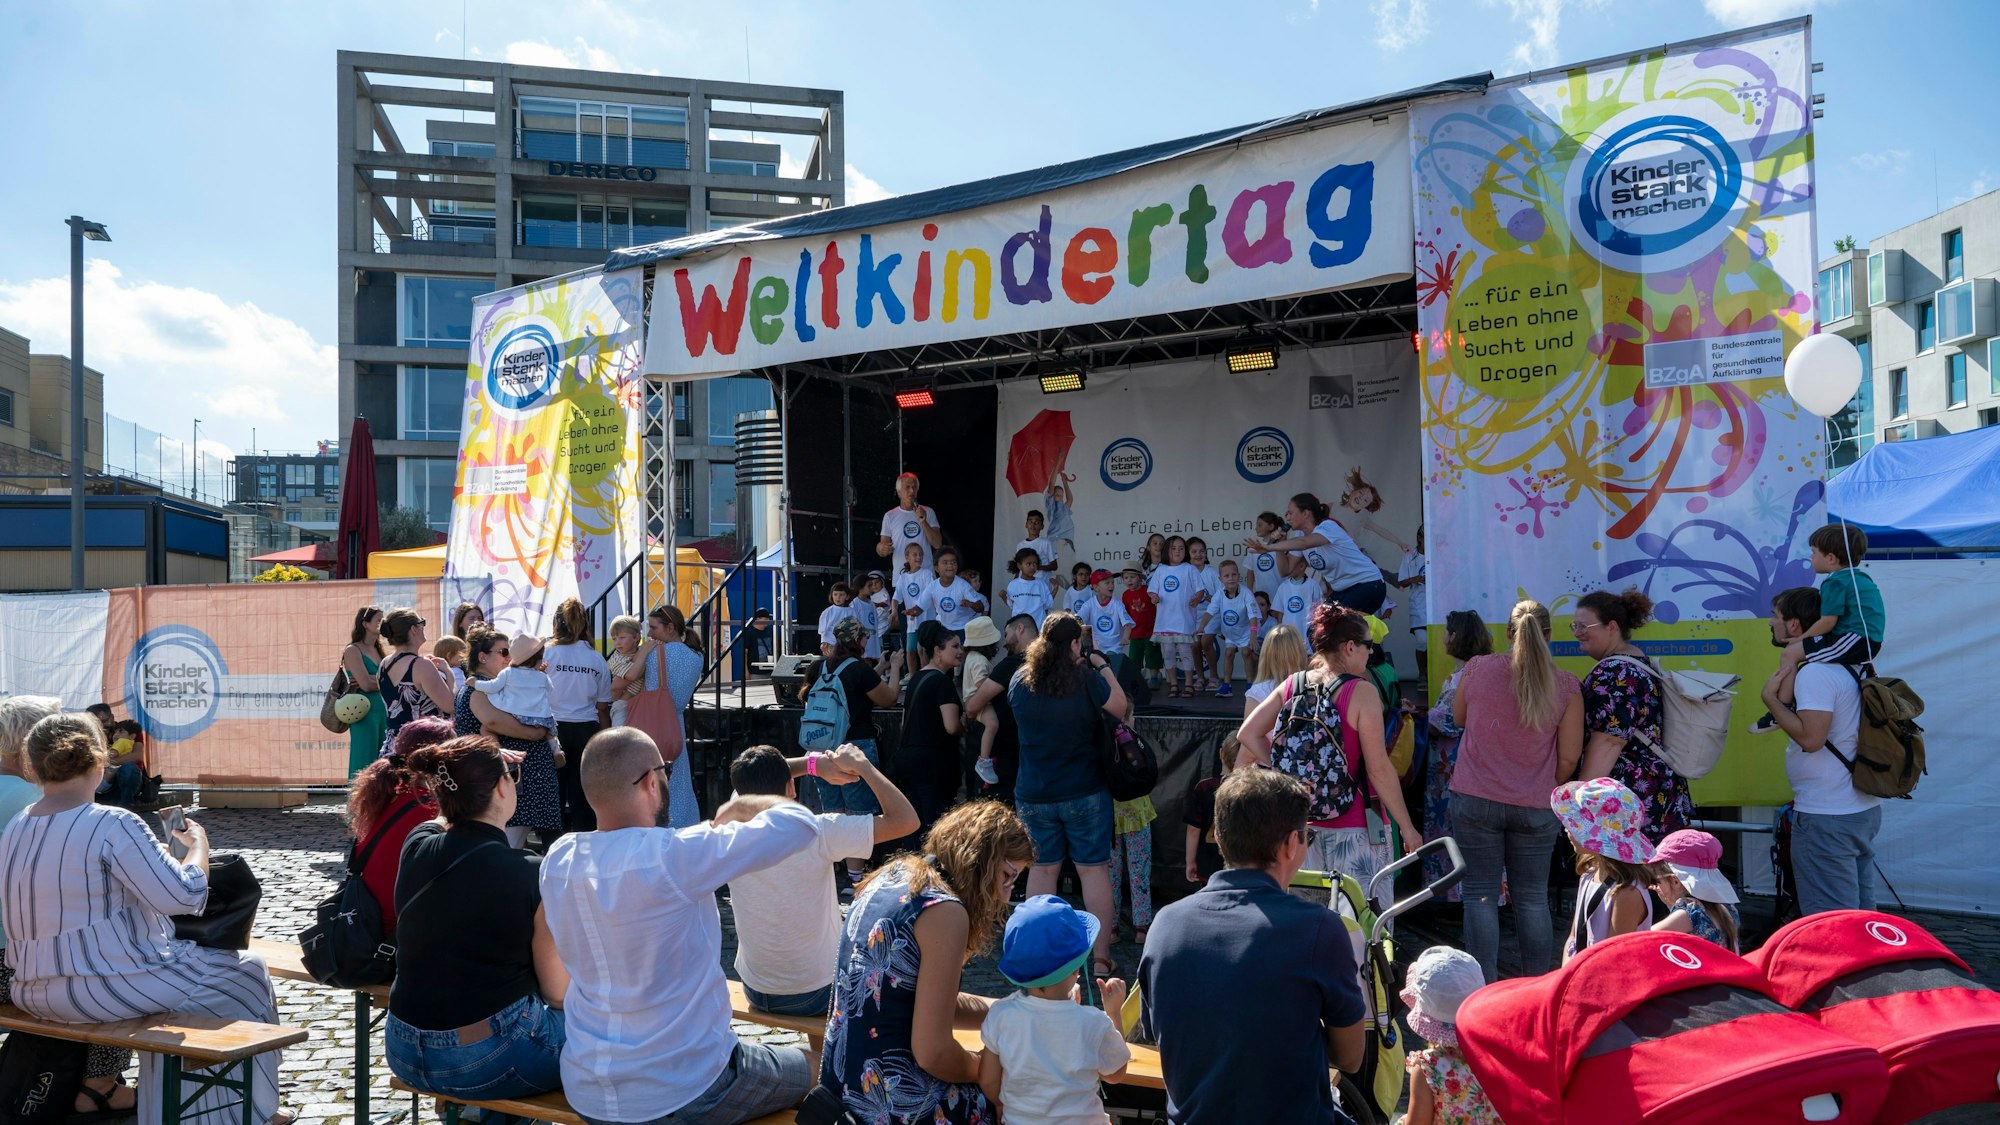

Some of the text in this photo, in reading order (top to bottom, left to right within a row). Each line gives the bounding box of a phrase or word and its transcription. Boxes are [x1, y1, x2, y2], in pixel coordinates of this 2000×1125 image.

[549, 161, 656, 181] DERECO
[1611, 159, 1706, 186] Kinder
[1611, 175, 1707, 204] stark
[1612, 196, 1706, 220] machen
[673, 161, 1374, 358] Weltkindertag
[1486, 286, 1521, 304] für
[1530, 281, 1568, 299] ein
[1457, 308, 1578, 334] Leben ohne
[1464, 331, 1573, 358] Sucht und
[1711, 336, 1782, 350] Bundeszentrale
[503, 351, 545, 364] Kinder
[1712, 355, 1782, 369] gesundheitliche
[502, 361, 544, 376] stark
[1480, 364, 1557, 382] Drogen
[1650, 364, 1704, 384] BZgA
[1712, 366, 1762, 378] Aufklärung
[501, 374, 544, 386] machen
[1311, 394, 1352, 408] BZgA
[573, 407, 590, 420] für
[594, 405, 615, 417] ein
[559, 424, 619, 440] Leben ohne
[560, 440, 616, 457] Sucht und
[1247, 445, 1282, 453] Kinder
[1247, 452, 1282, 461] stark
[1111, 454, 1142, 463] Kinder
[1111, 462, 1142, 470] stark
[1130, 521, 1157, 535] für
[1163, 519, 1194, 533] ein
[1201, 517, 1253, 532] Leben
[1094, 547, 1131, 561] ohne
[1206, 543, 1225, 557] nd
[145, 663, 208, 679] Kinder
[556, 664, 600, 677] SECURITY
[145, 679, 208, 695] stark
[145, 695, 208, 708] machen
[228, 686, 248, 707] für
[254, 689, 272, 707] ein
